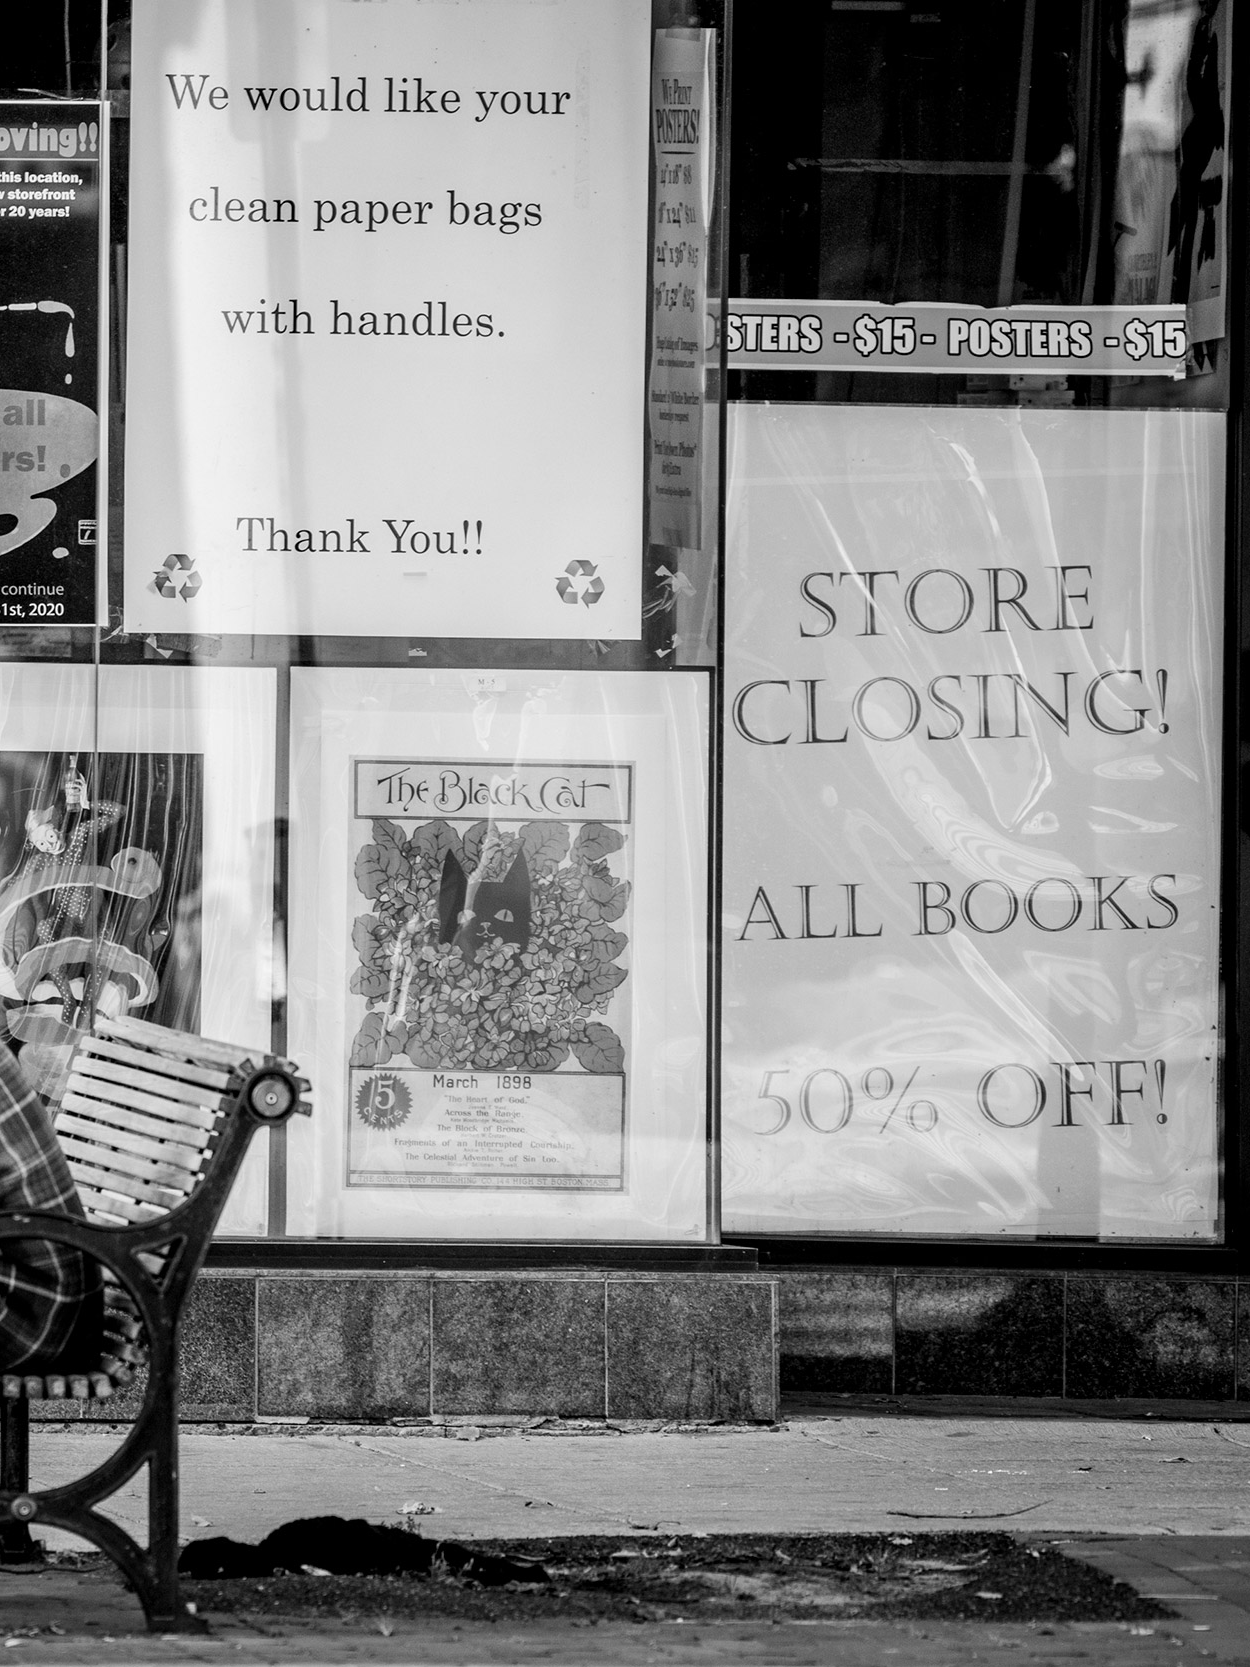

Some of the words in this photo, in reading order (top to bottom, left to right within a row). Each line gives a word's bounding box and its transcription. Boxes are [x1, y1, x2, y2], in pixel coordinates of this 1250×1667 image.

[165, 73, 230, 111] We
[244, 77, 370, 113] would
[384, 77, 462, 115] like
[475, 87, 571, 123] your
[656, 108, 701, 144] POSTERS!
[24, 172, 83, 187] location,
[7, 188, 76, 201] storefront
[8, 205, 26, 218] 20
[28, 205, 70, 220] years!
[188, 187, 298, 224] clean
[312, 195, 433, 232] paper
[447, 191, 543, 235] bags
[221, 298, 315, 336] with
[330, 302, 506, 339] handles.
[947, 318, 1093, 358] POSTERS
[2, 398, 47, 427] all
[236, 517, 370, 554] Thank
[382, 520, 484, 557] You!!
[1, 582, 65, 597] continue
[28, 603, 65, 618] 2020
[799, 564, 1095, 640] STORE
[732, 668, 1170, 746] CLOSING!
[377, 767, 430, 813] The
[433, 770, 543, 814] Black
[539, 776, 611, 814] Cat
[734, 882, 883, 943] ALL
[910, 873, 1179, 936] BOOKS
[432, 1074, 479, 1090] March
[496, 1075, 533, 1091] 1898
[374, 1080, 396, 1110] 5
[466, 1095, 488, 1103] Heart
[493, 1096, 504, 1104] of
[754, 1064, 939, 1137] 50%
[976, 1058, 1169, 1129] OFF!
[363, 1107, 404, 1126] CENTS
[444, 1109, 472, 1118] Across
[476, 1110, 489, 1118] the
[495, 1110, 525, 1120] Range.
[437, 1124, 452, 1132] The
[455, 1124, 478, 1132] Block
[483, 1125, 493, 1133] of
[496, 1126, 528, 1134] Bronze.
[394, 1138, 437, 1148] Fragments
[441, 1139, 452, 1147] of
[474, 1140, 523, 1149] Interrupted
[530, 1141, 575, 1151] Courtship.
[405, 1152, 419, 1160] The
[423, 1153, 457, 1161] Celestial
[462, 1154, 504, 1162] Adventure
[523, 1155, 536, 1163] Sin
[358, 1175, 374, 1183] THE
[376, 1175, 427, 1184] SHORTSTORY
[430, 1176, 477, 1185] PUBLISHING
[512, 1178, 535, 1186] HIGH
